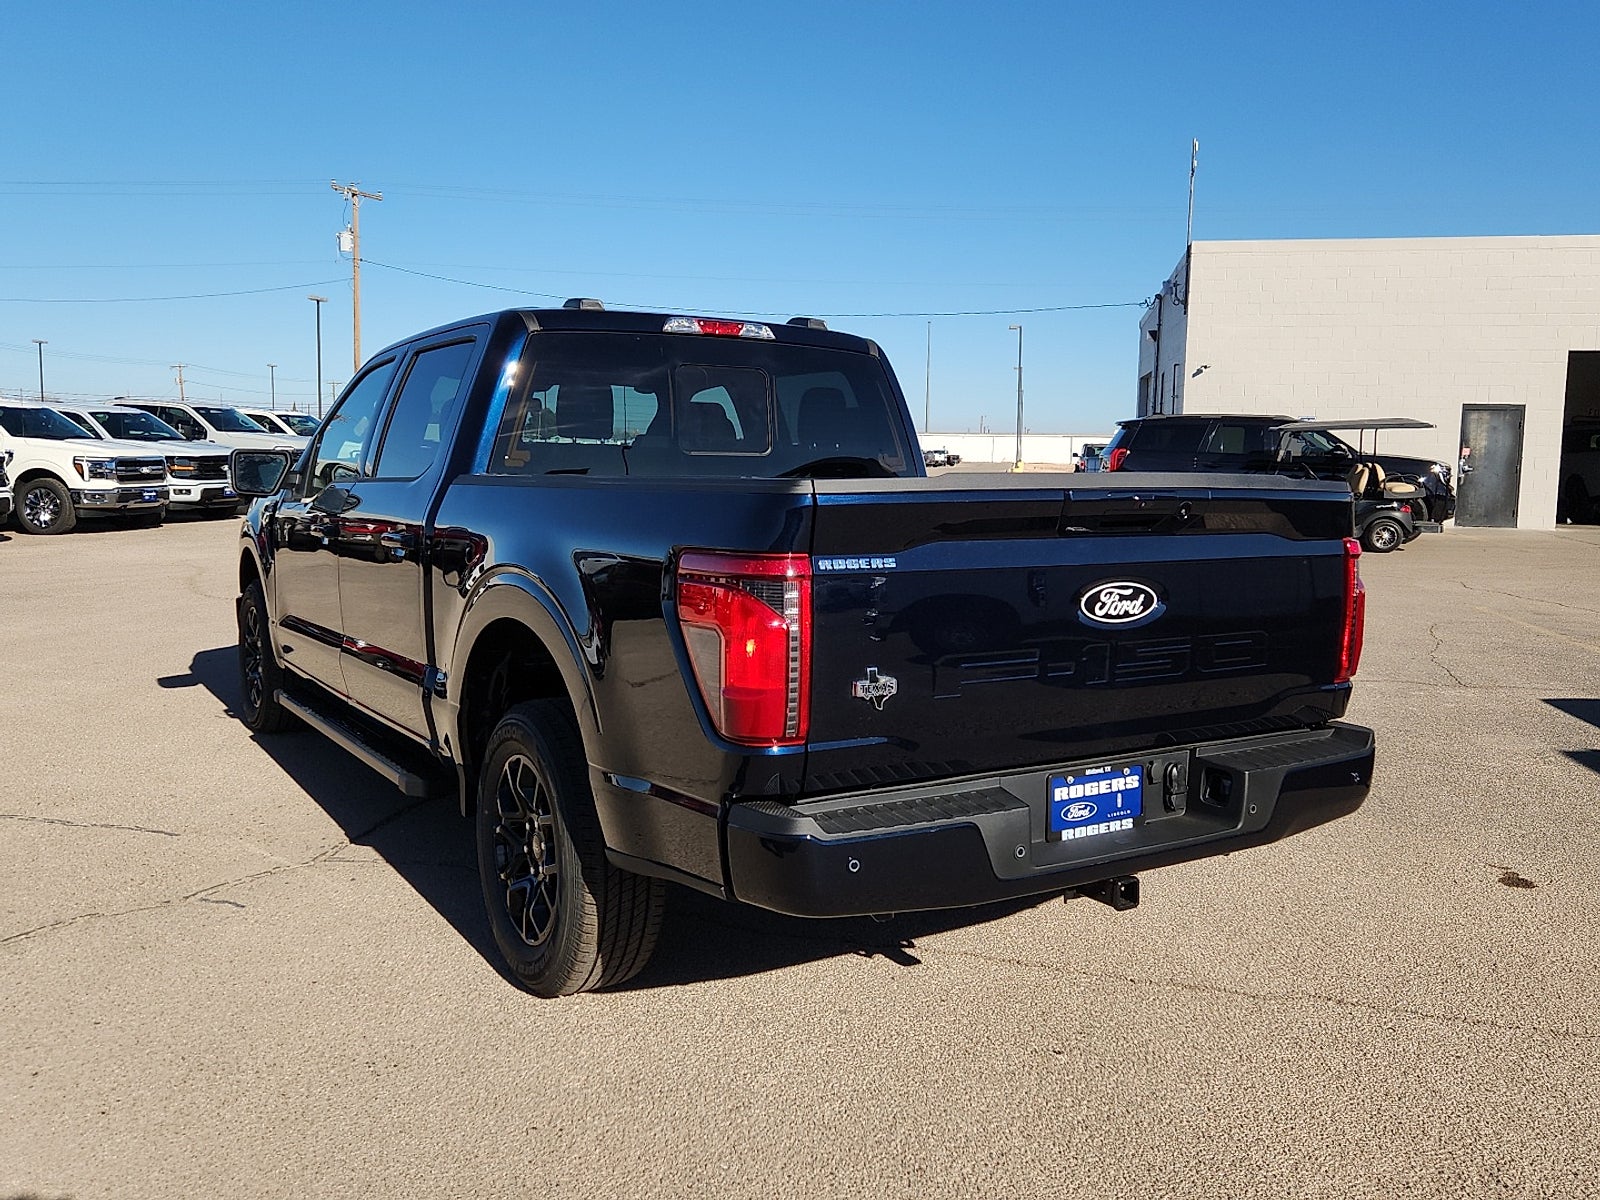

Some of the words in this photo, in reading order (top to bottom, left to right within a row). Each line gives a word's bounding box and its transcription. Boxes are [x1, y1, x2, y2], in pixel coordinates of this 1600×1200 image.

[818, 557, 897, 570] ROGERS
[1094, 588, 1145, 616] Ford
[933, 630, 1268, 699] F-150
[860, 682, 895, 696] TEXAS
[1054, 775, 1140, 802] ROGERS
[1067, 804, 1091, 819] Ford
[1061, 818, 1134, 841] ROGERS
